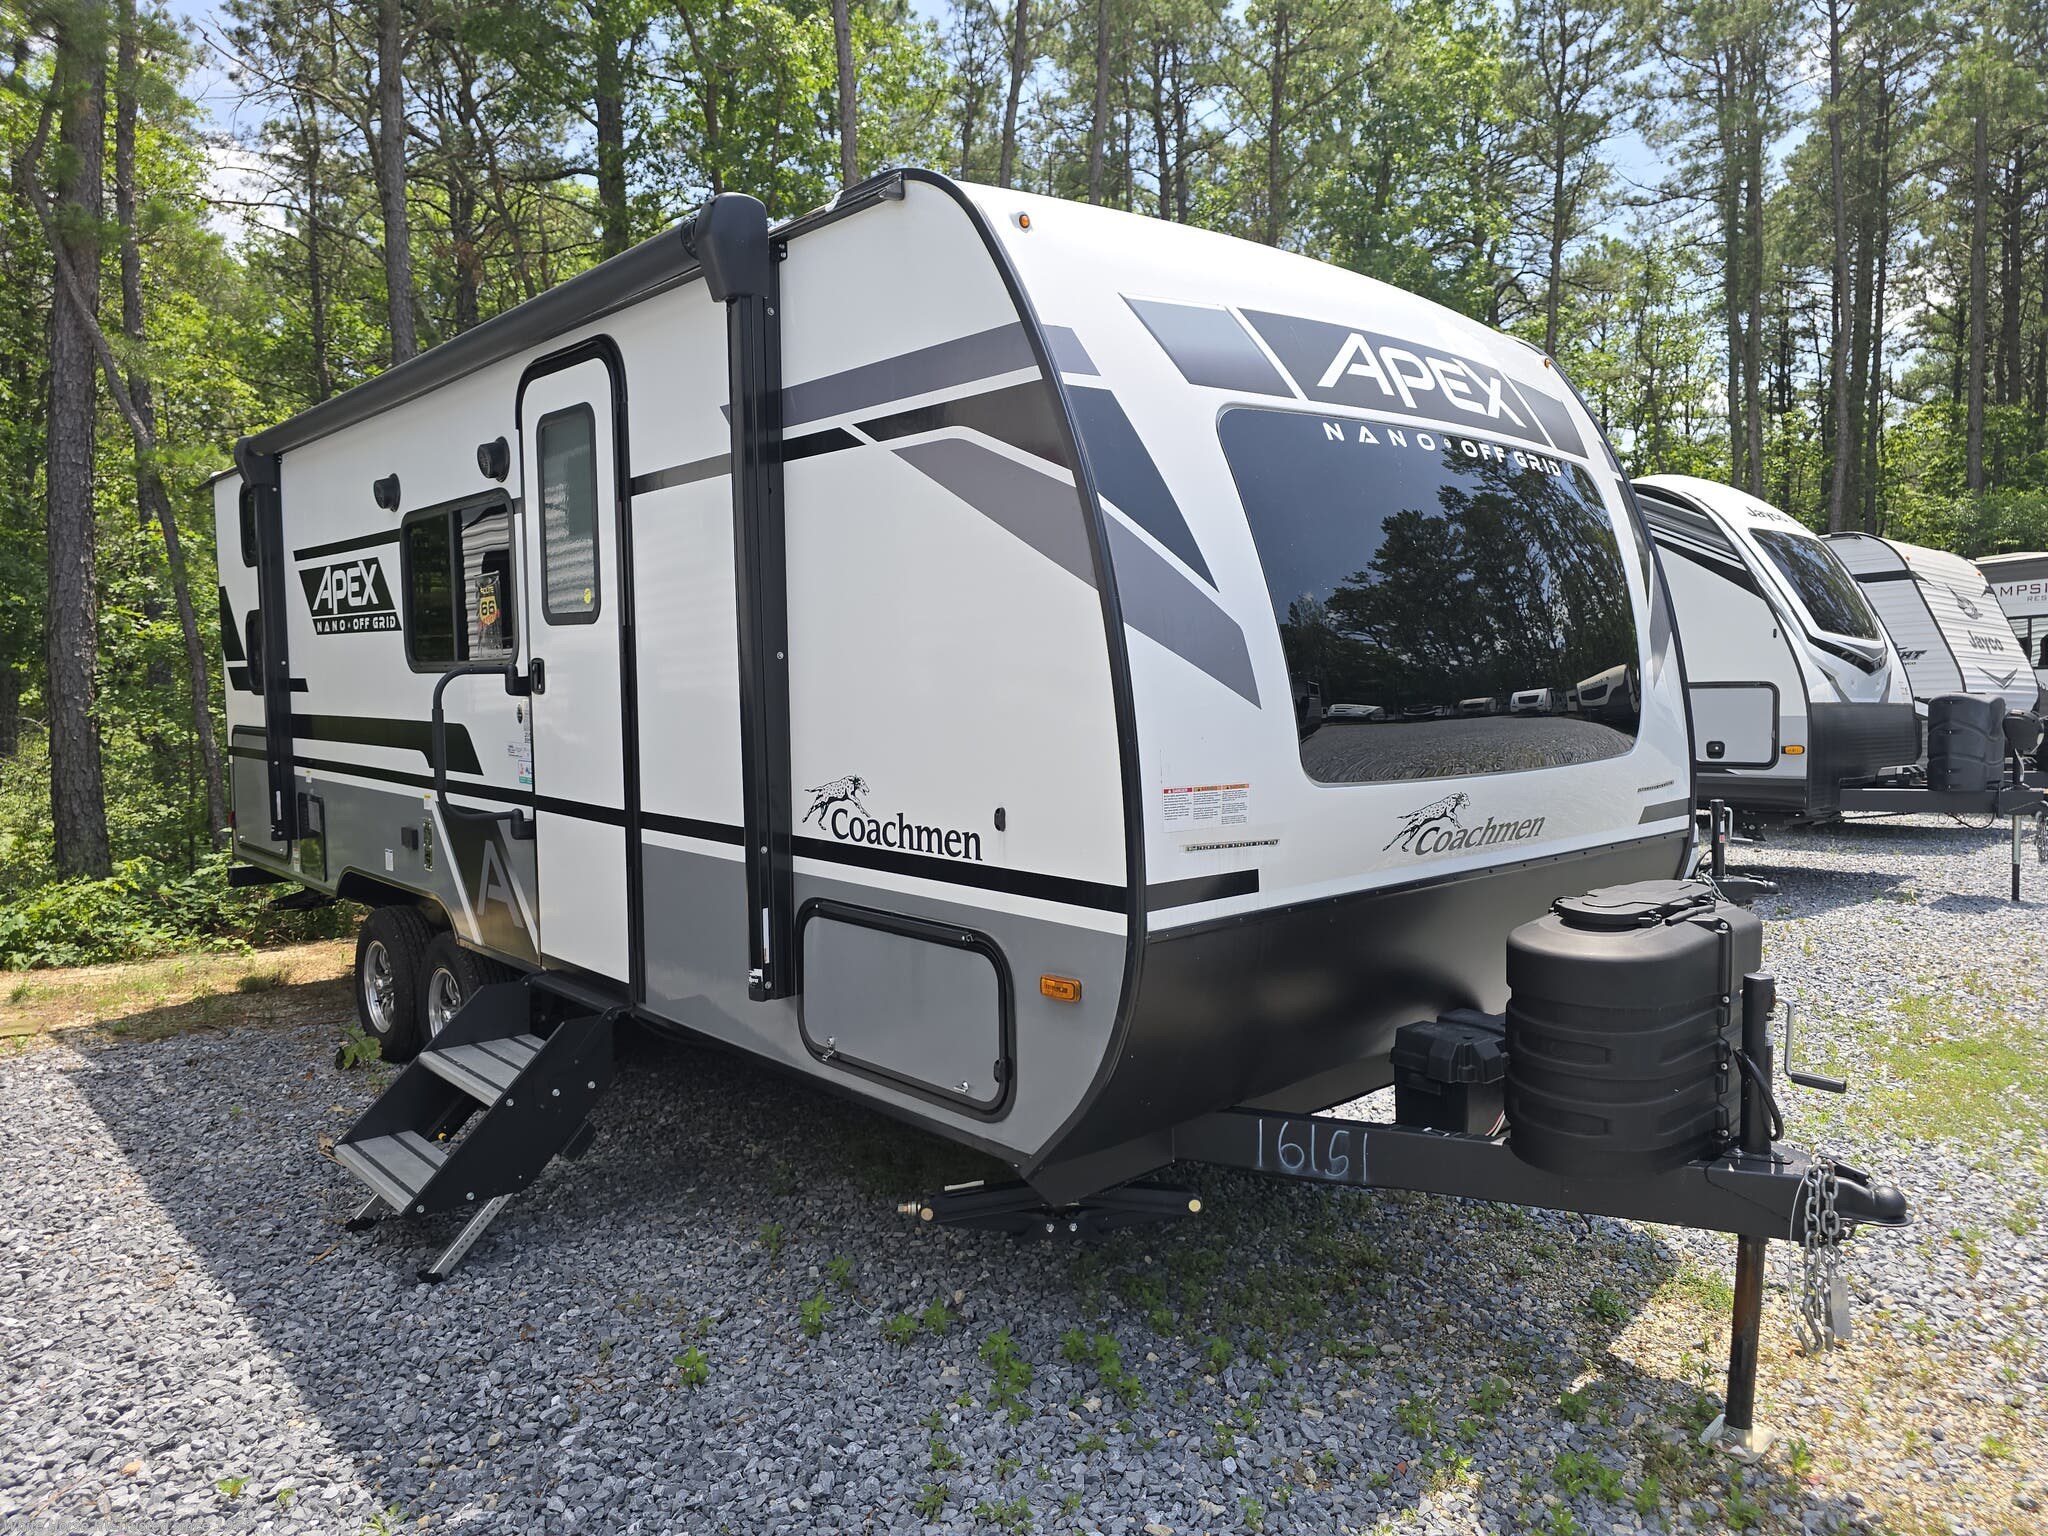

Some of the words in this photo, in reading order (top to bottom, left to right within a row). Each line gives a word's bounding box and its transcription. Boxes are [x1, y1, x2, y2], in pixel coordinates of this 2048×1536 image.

[1317, 332, 1528, 428] APEX
[1322, 421, 1437, 451] NANO
[1460, 439, 1506, 463] OFF
[1514, 450, 1562, 478] GRID
[312, 560, 379, 615] APEX
[480, 599, 496, 617] 66
[316, 619, 346, 633] NANO
[352, 616, 370, 630] OFF
[372, 615, 396, 629] GRID
[1967, 629, 2005, 655] Jayco
[831, 807, 983, 861] Coachmen
[1414, 816, 1546, 856] Coachmen
[1259, 1118, 1368, 1185] 16151
